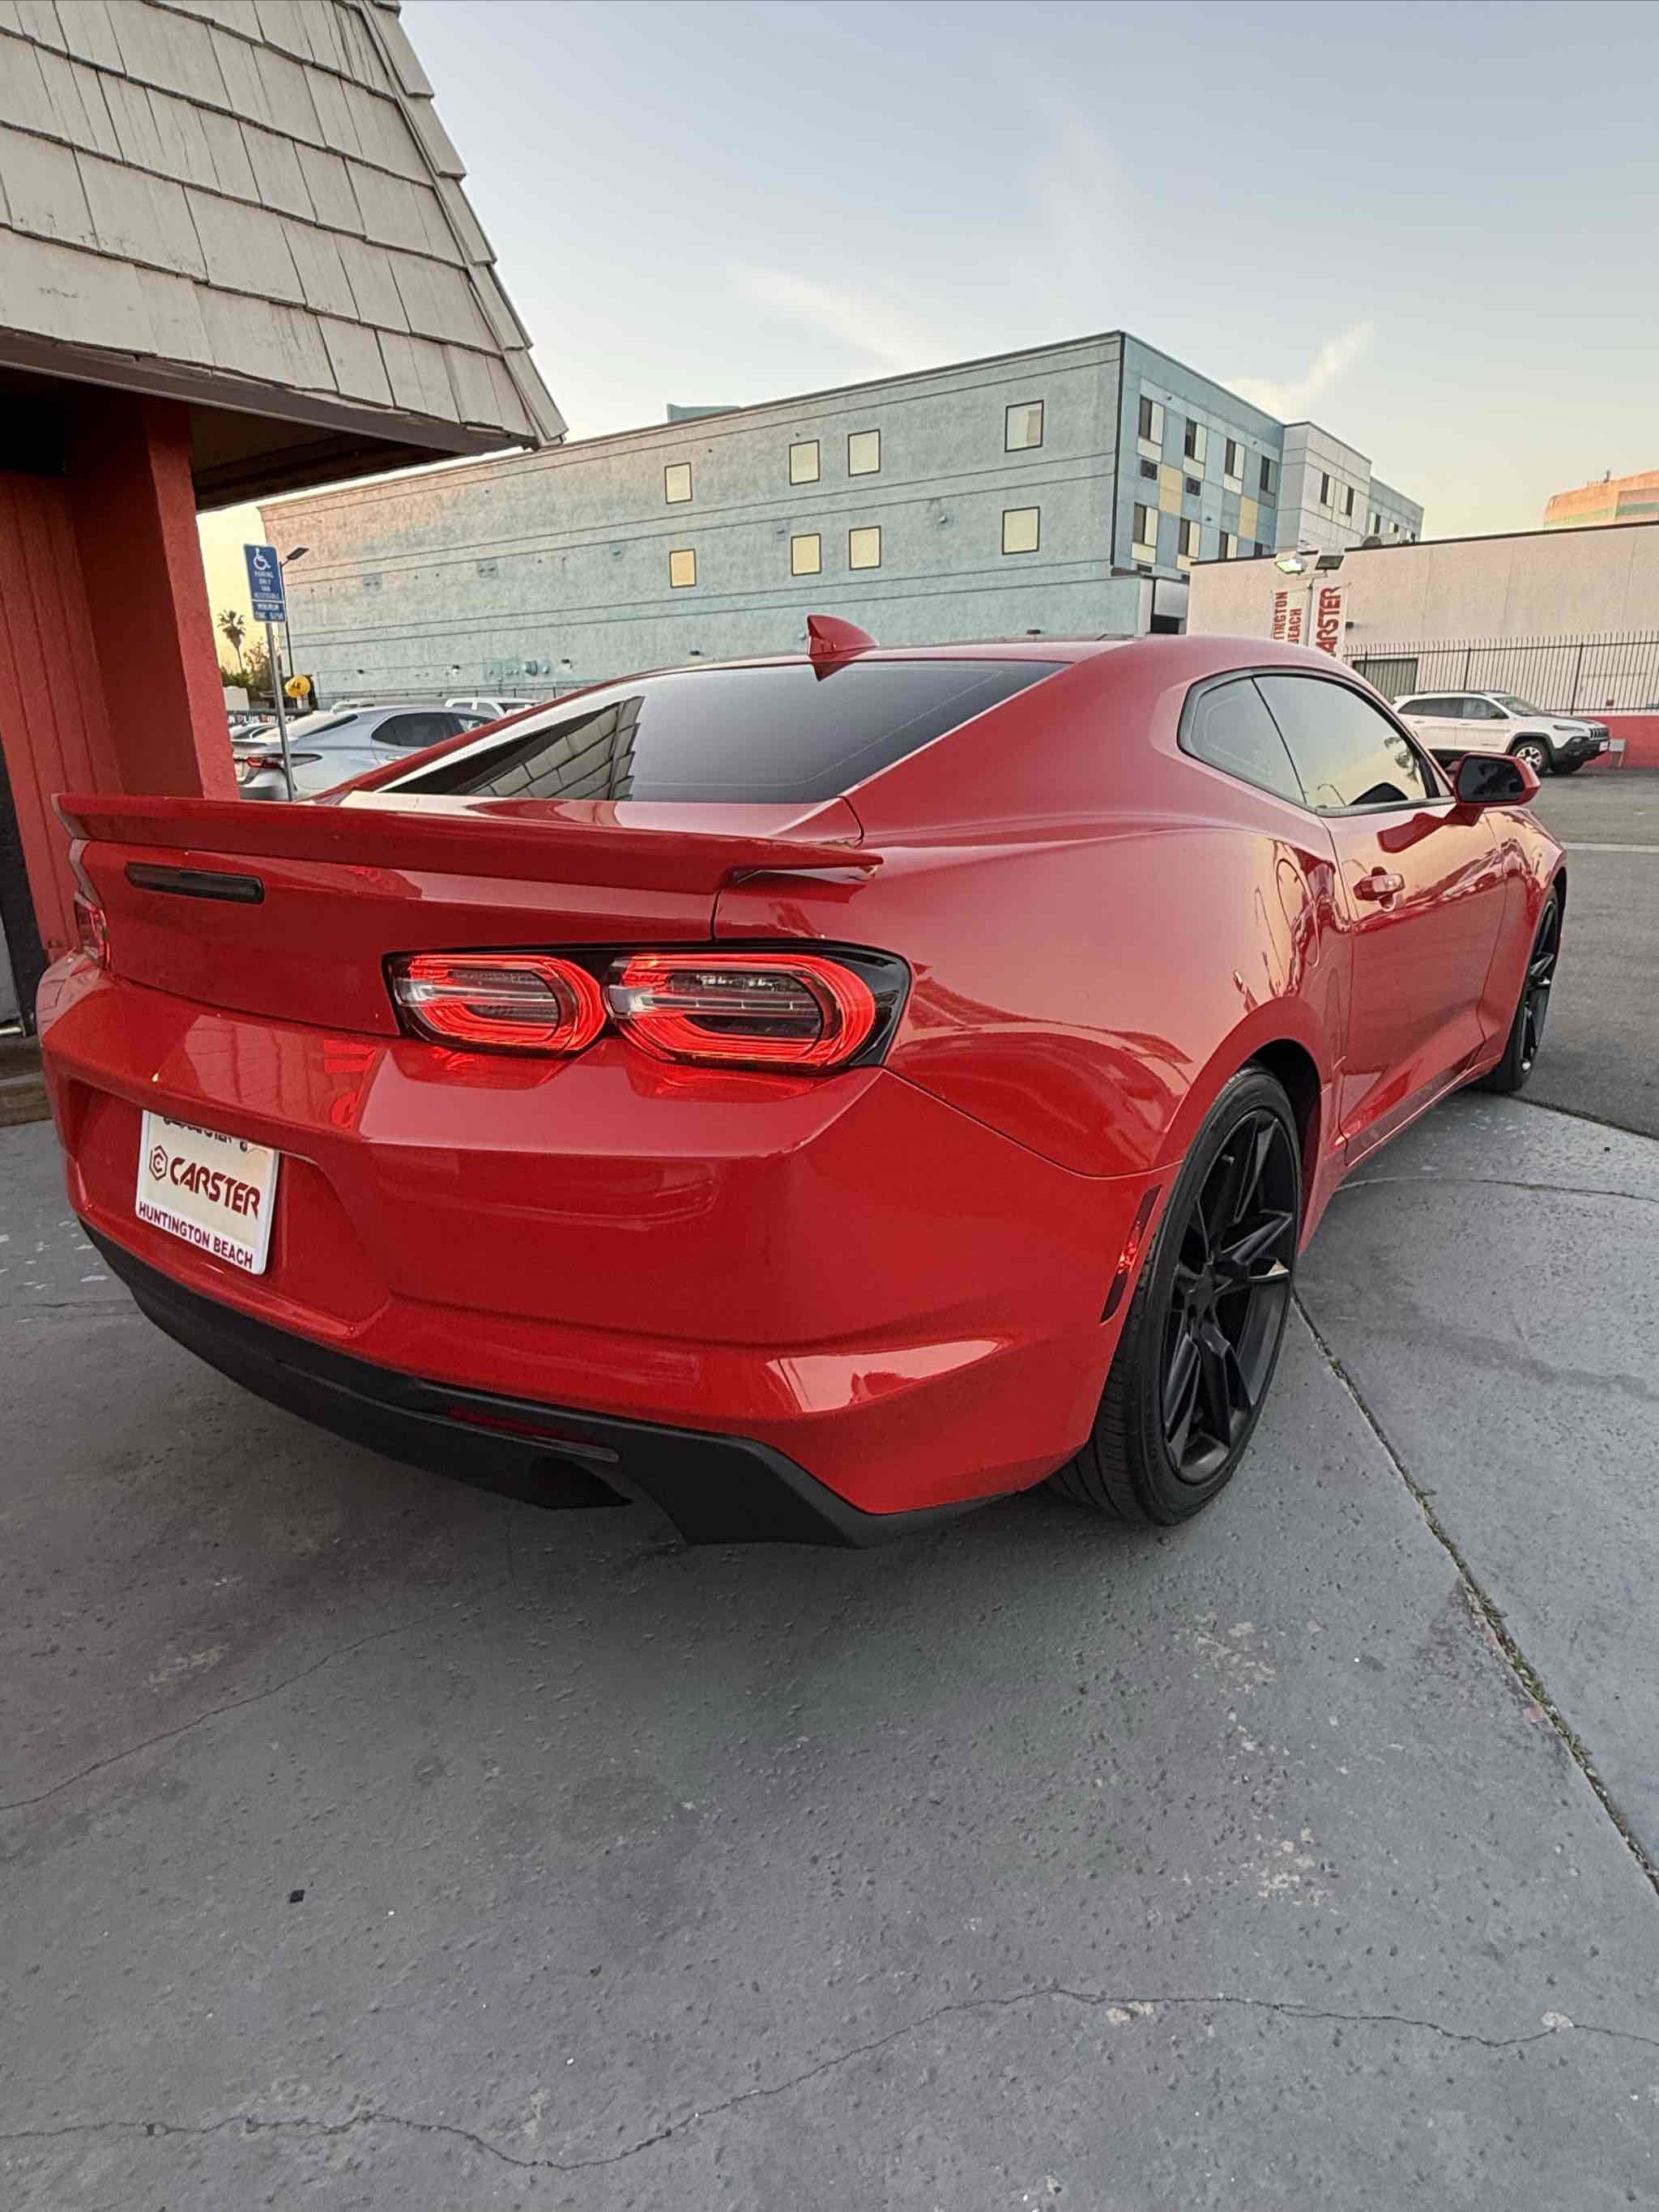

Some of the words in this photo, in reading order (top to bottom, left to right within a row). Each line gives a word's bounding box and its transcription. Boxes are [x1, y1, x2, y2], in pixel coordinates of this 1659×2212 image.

[1316, 586, 1341, 658] ARSTER
[170, 1157, 261, 1219] CARSTER
[139, 1202, 211, 1249] HUNTINGTON
[214, 1235, 254, 1268] BEACH
